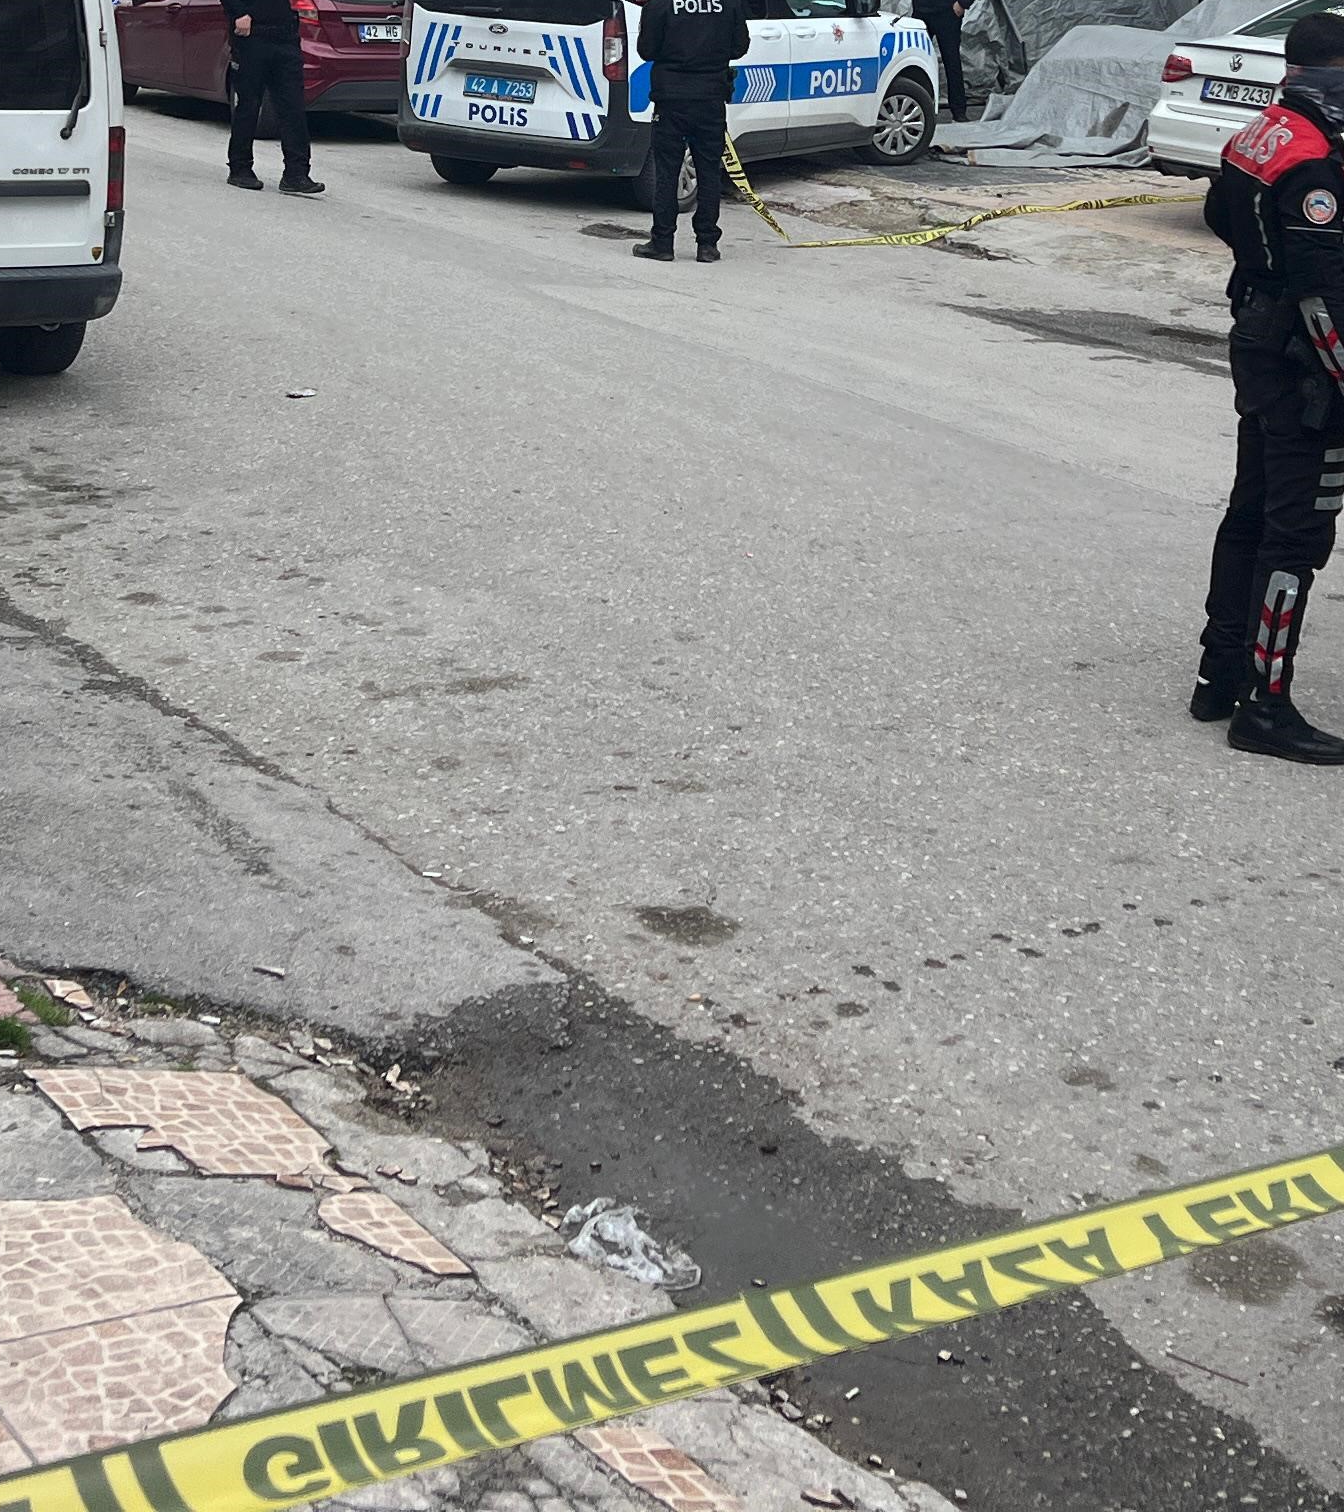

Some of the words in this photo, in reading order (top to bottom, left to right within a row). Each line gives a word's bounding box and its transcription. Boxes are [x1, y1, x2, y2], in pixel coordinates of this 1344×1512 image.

[366, 25, 378, 38] 42
[471, 77, 487, 93] 42
[490, 79, 498, 94] A
[504, 80, 534, 97] 7253
[1208, 81, 1223, 98] 42
[1241, 87, 1271, 105] 2433
